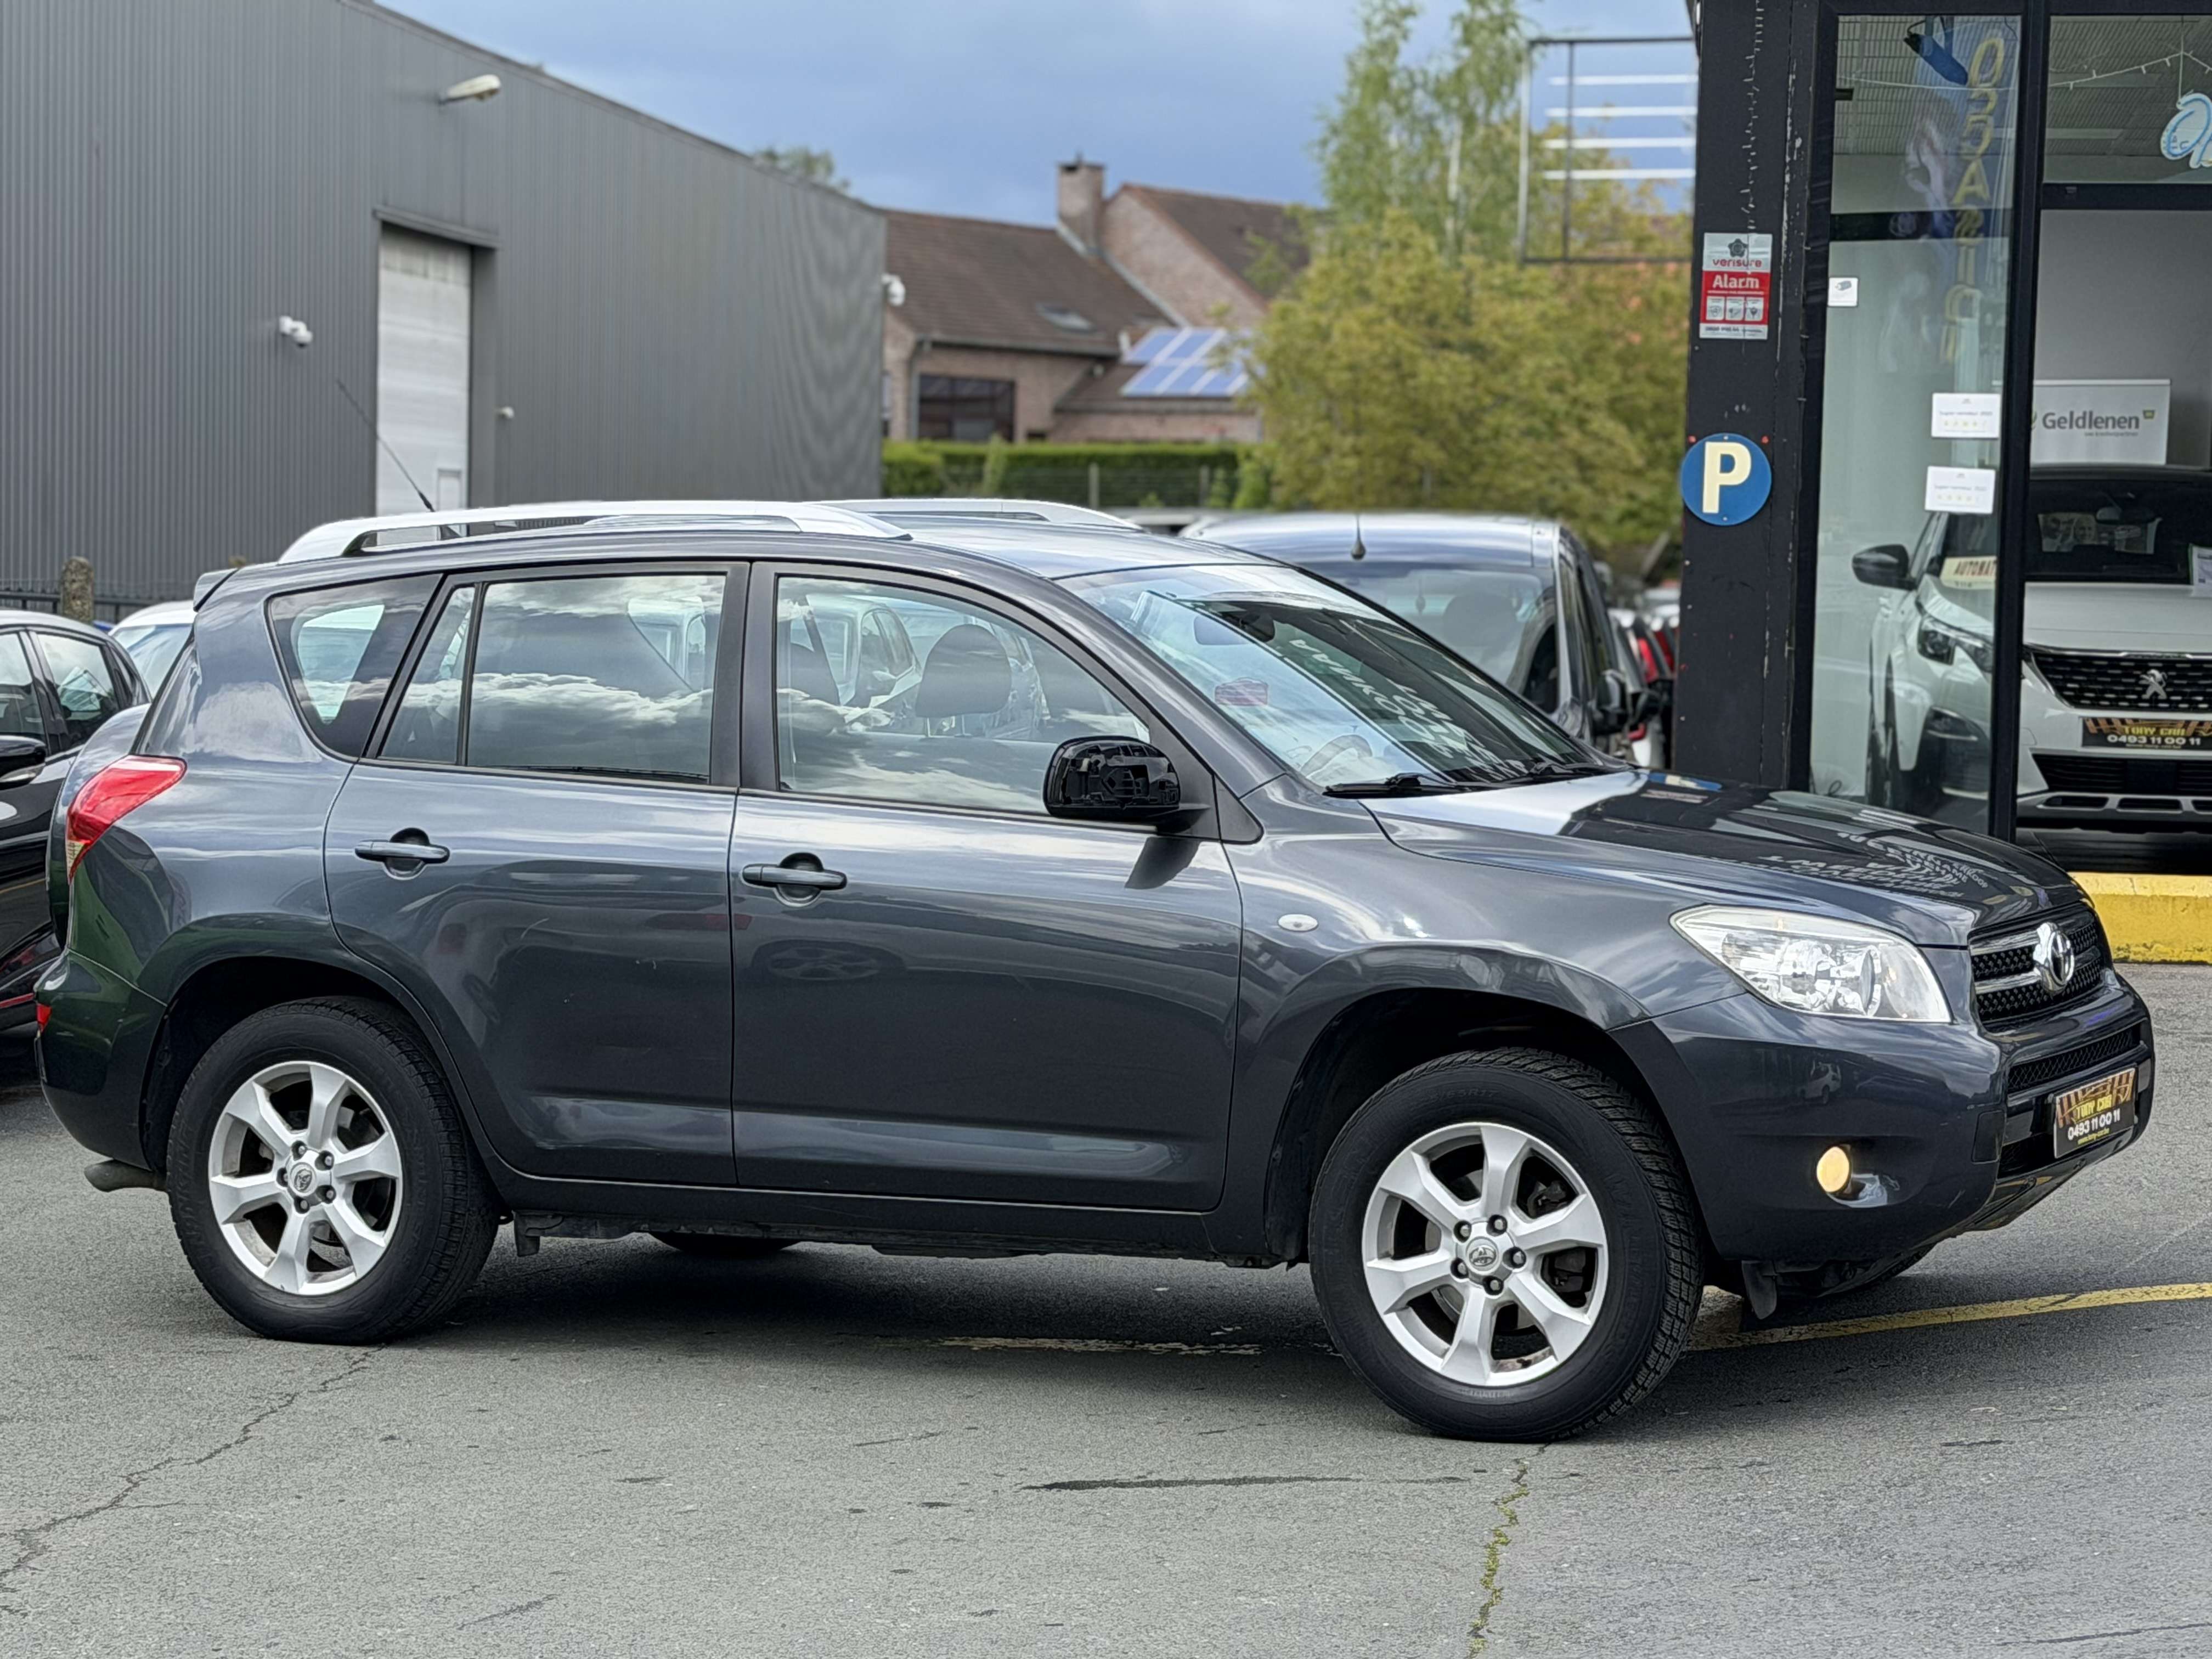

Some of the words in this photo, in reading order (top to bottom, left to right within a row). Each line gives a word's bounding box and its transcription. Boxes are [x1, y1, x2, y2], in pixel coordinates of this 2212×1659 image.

[1712, 273, 1760, 289] Alarm
[2042, 410, 2139, 430] Geldlenen
[1703, 441, 1752, 514] P
[2107, 734, 2147, 744] 0493
[2068, 1120, 2090, 1141] 0493
[2091, 1116, 2098, 1131] 11
[2099, 1111, 2112, 1127] 00
[2113, 1108, 2120, 1122] 11
